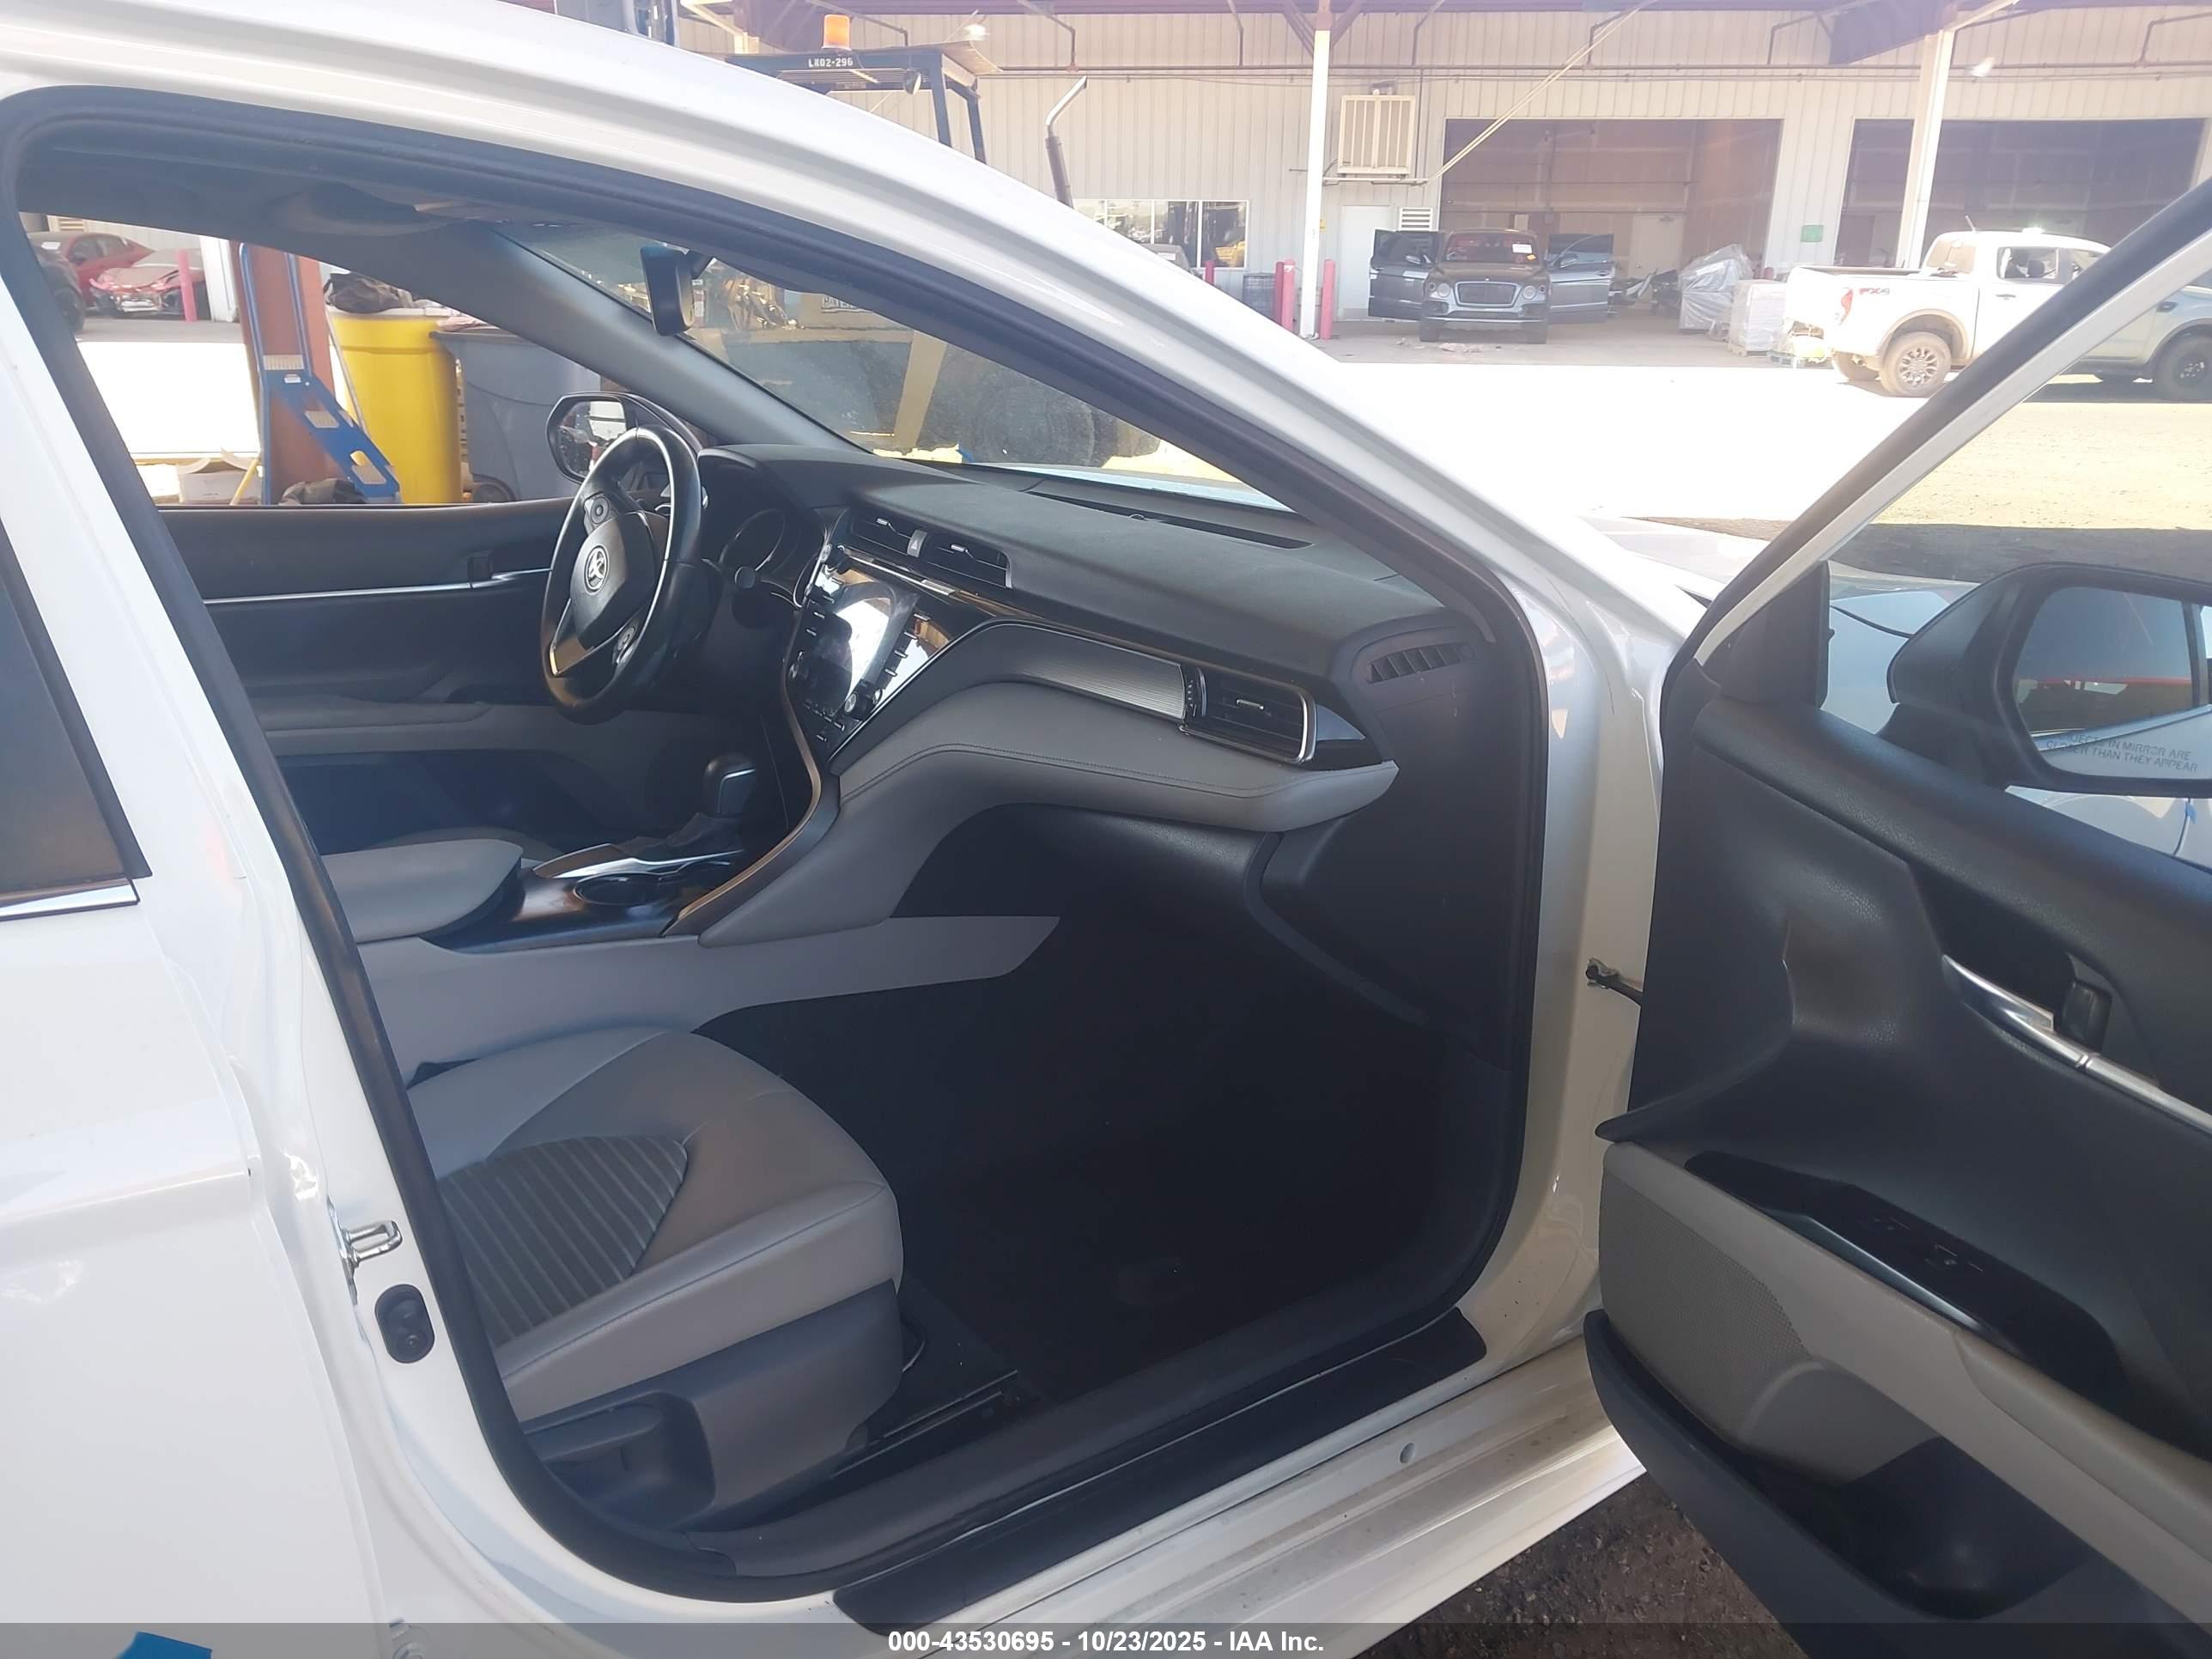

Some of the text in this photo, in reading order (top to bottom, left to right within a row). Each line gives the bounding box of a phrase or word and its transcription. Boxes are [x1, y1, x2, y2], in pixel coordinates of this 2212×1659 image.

[2093, 747, 2121, 760] THAN
[2124, 752, 2152, 766] THEY
[2154, 757, 2198, 773] APPEAR
[2108, 739, 2120, 750] IN
[2122, 741, 2166, 757] MIRROR
[2168, 749, 2192, 761] ARE
